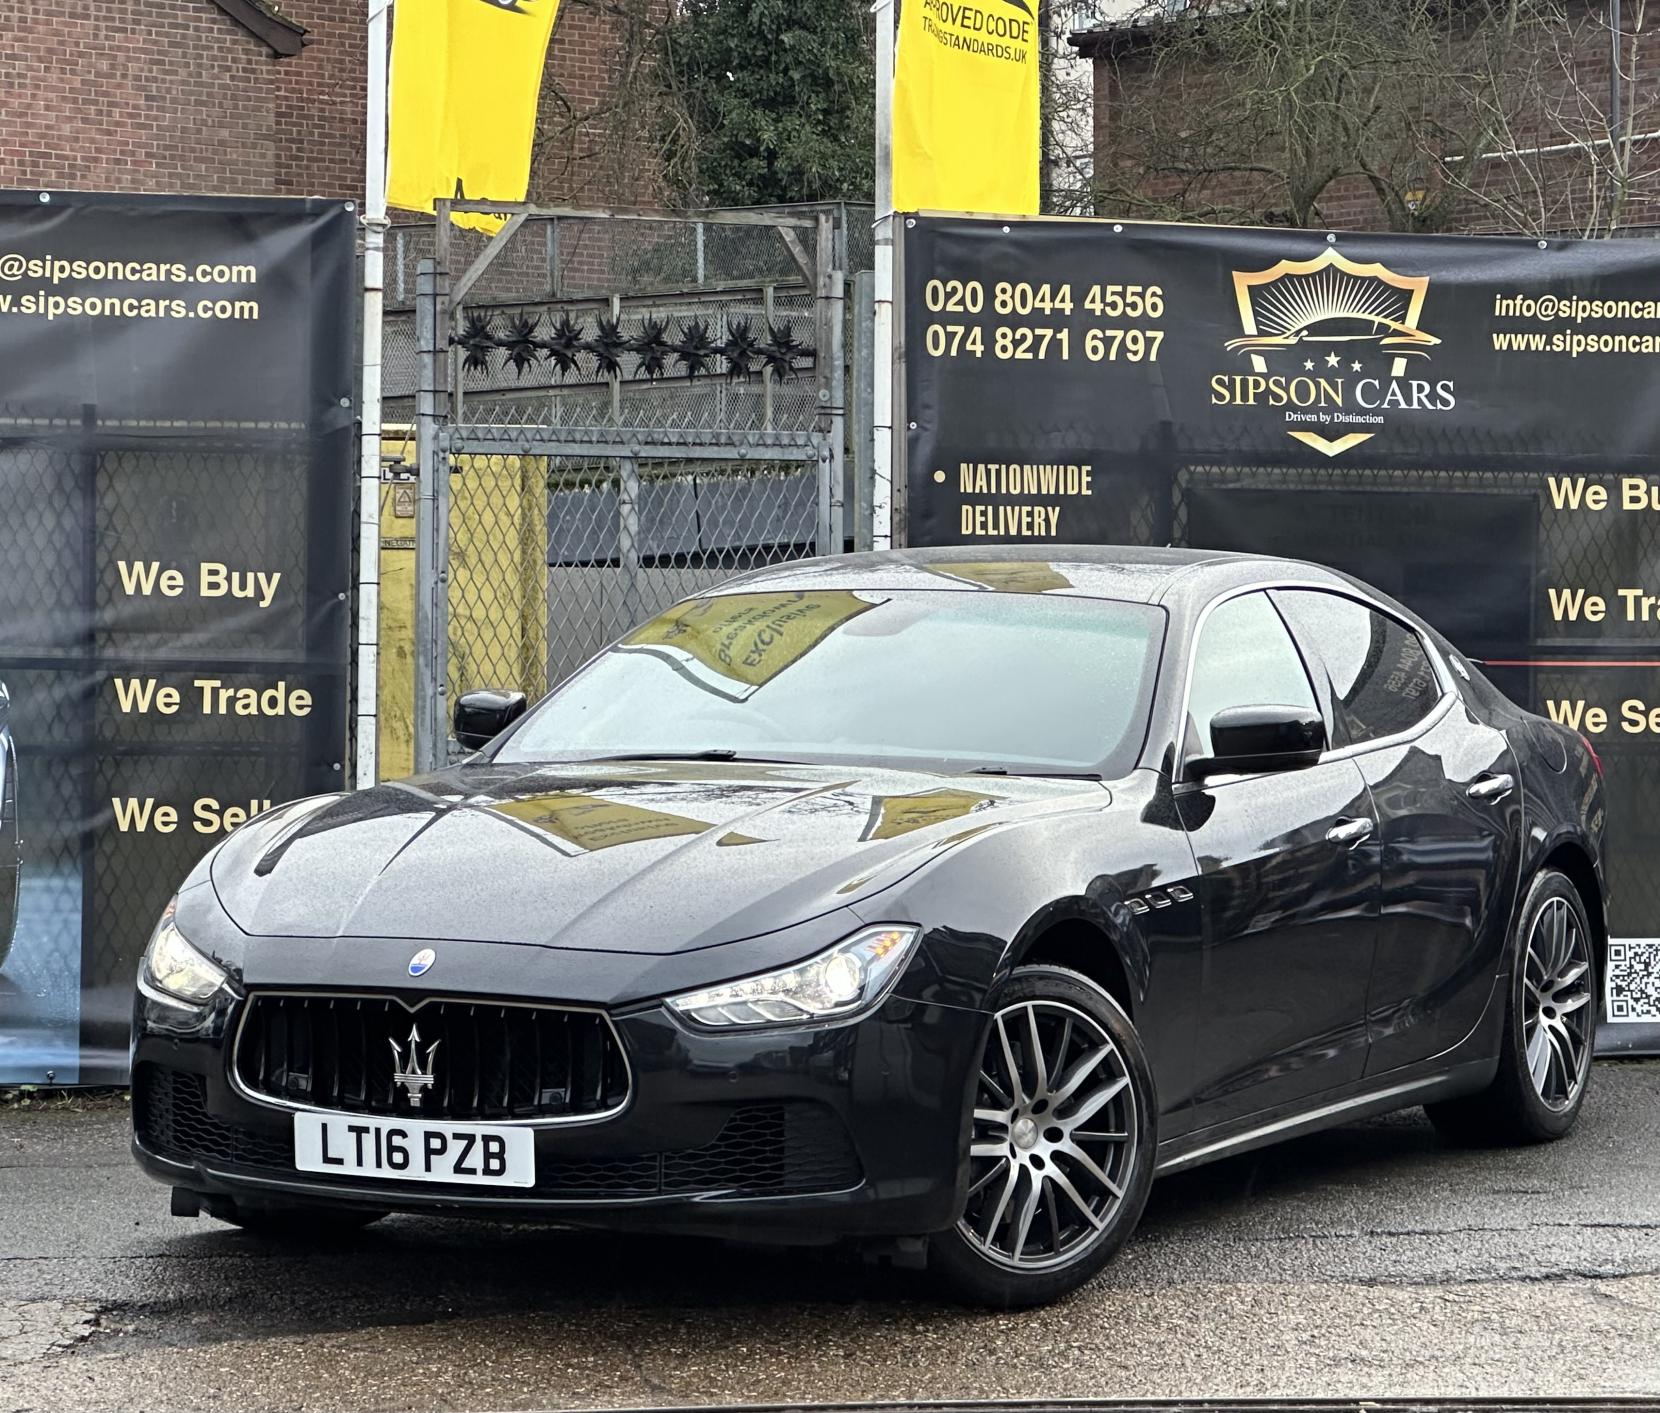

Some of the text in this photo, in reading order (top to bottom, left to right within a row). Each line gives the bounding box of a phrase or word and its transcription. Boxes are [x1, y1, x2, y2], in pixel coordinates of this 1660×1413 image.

[986, 14, 1029, 43] CODE
[926, 280, 1163, 318] 020 8044 4556
[927, 324, 1164, 361] 074 8271 6797
[1212, 375, 1455, 410] SIPSON CARS
[1286, 412, 1383, 424] Driven by Distinction
[960, 463, 1092, 495] NATIONWIDE
[1548, 477, 1607, 510] We
[962, 505, 1060, 536] DELIVERY
[118, 561, 281, 607] We Buy
[1549, 589, 1660, 621] We Tr
[114, 679, 312, 716] We Trade
[1546, 700, 1608, 733] We
[112, 798, 177, 833] We
[322, 1123, 506, 1176] LT16 PZB
